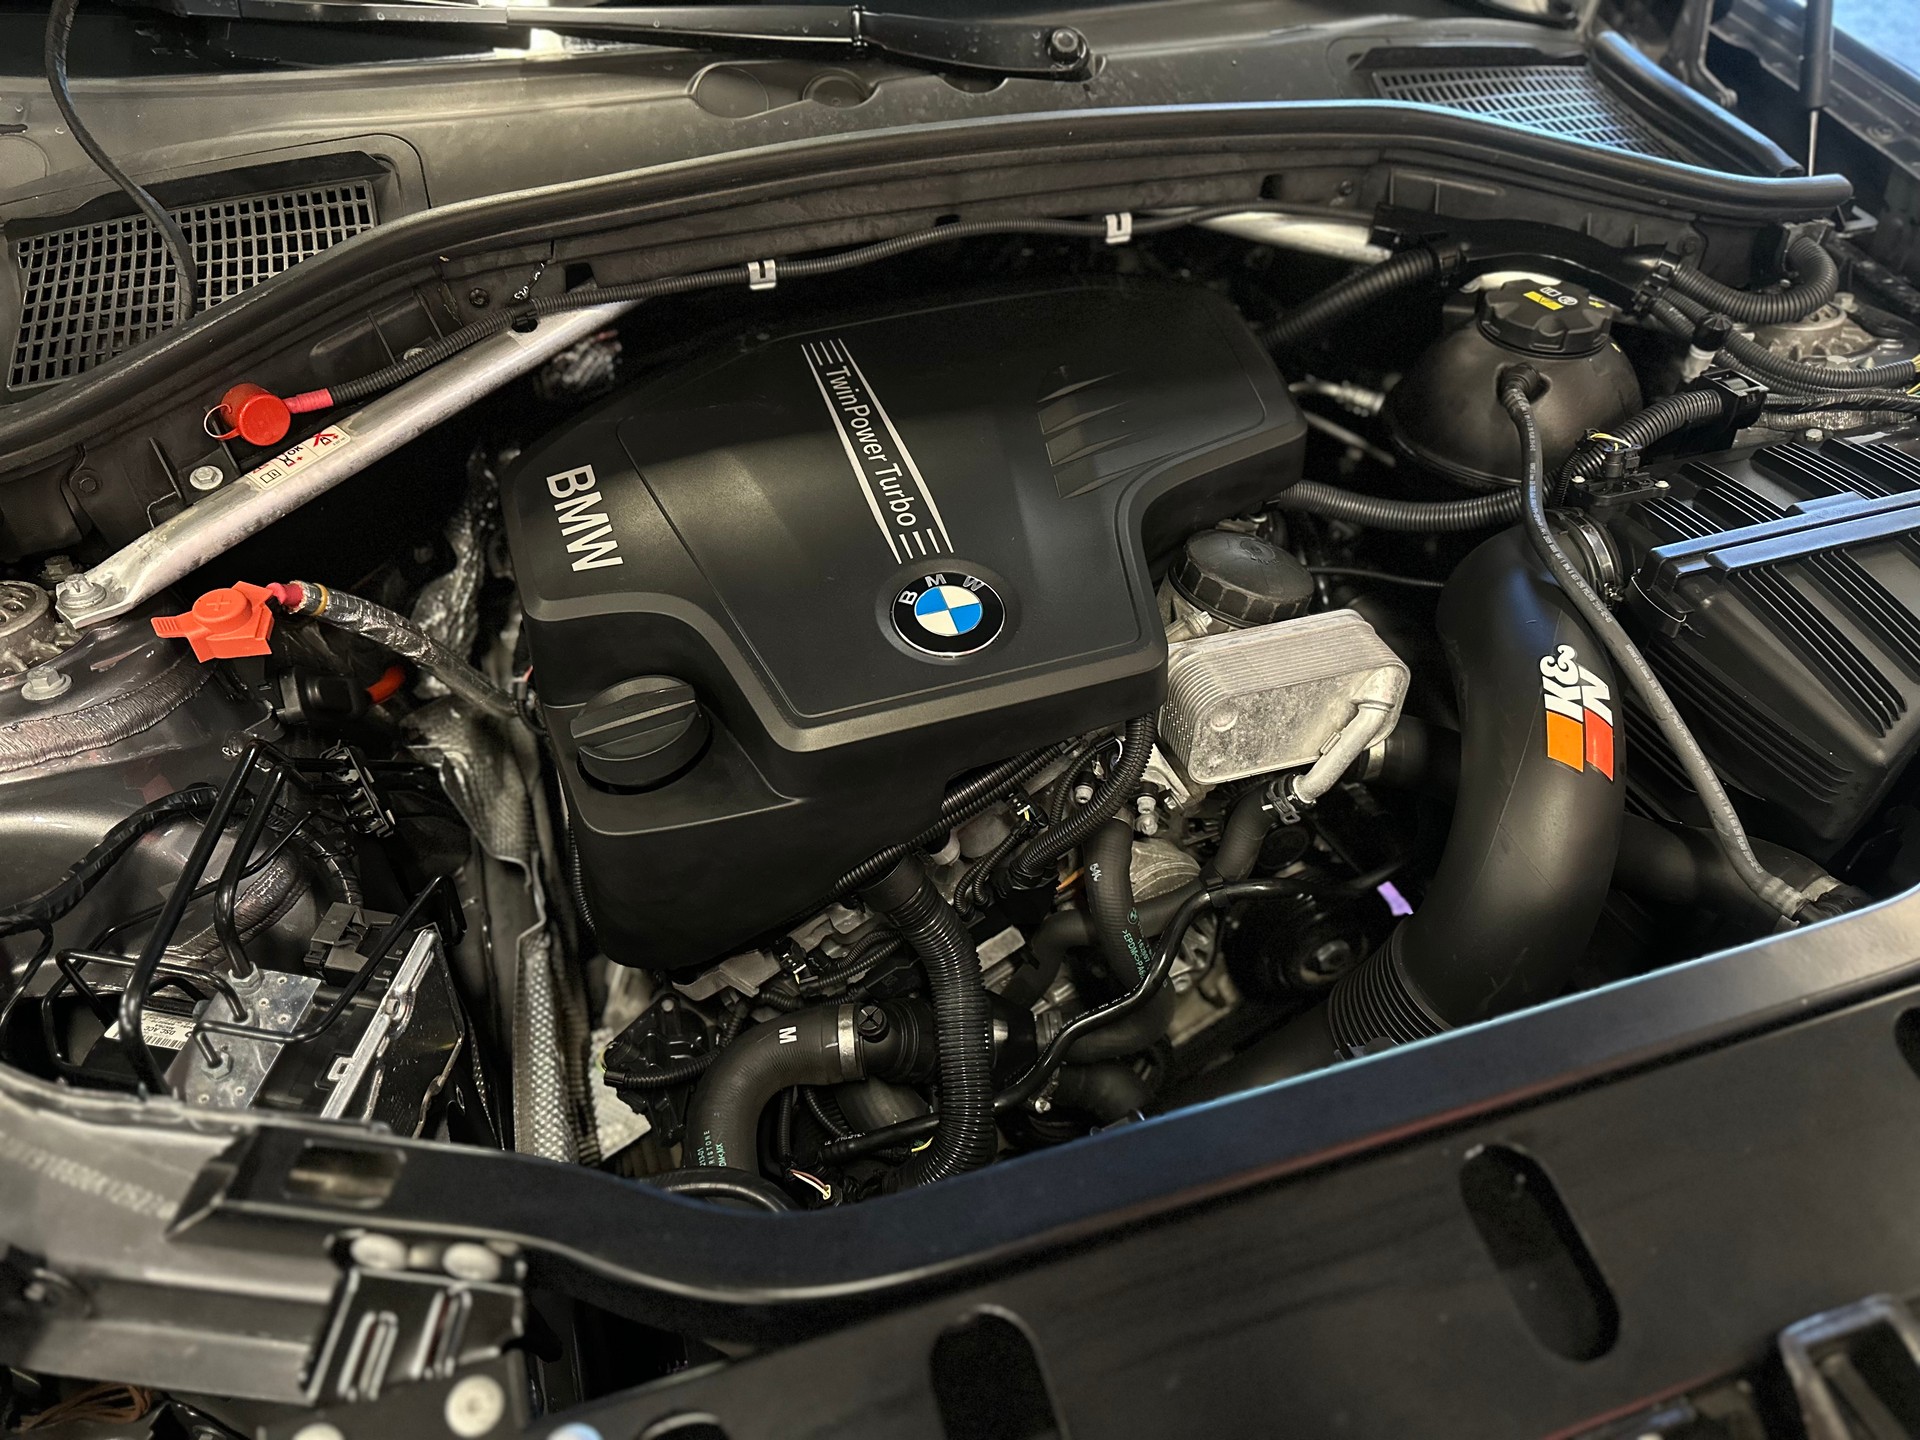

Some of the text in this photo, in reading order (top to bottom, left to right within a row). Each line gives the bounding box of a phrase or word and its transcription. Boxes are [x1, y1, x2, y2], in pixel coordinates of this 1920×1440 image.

[287, 446, 304, 455] OK
[826, 365, 917, 527] TwinPower Turbo
[546, 464, 624, 572] BMW
[898, 573, 986, 606] BMW
[1540, 644, 1614, 727] K&N
[778, 1026, 797, 1044] M
